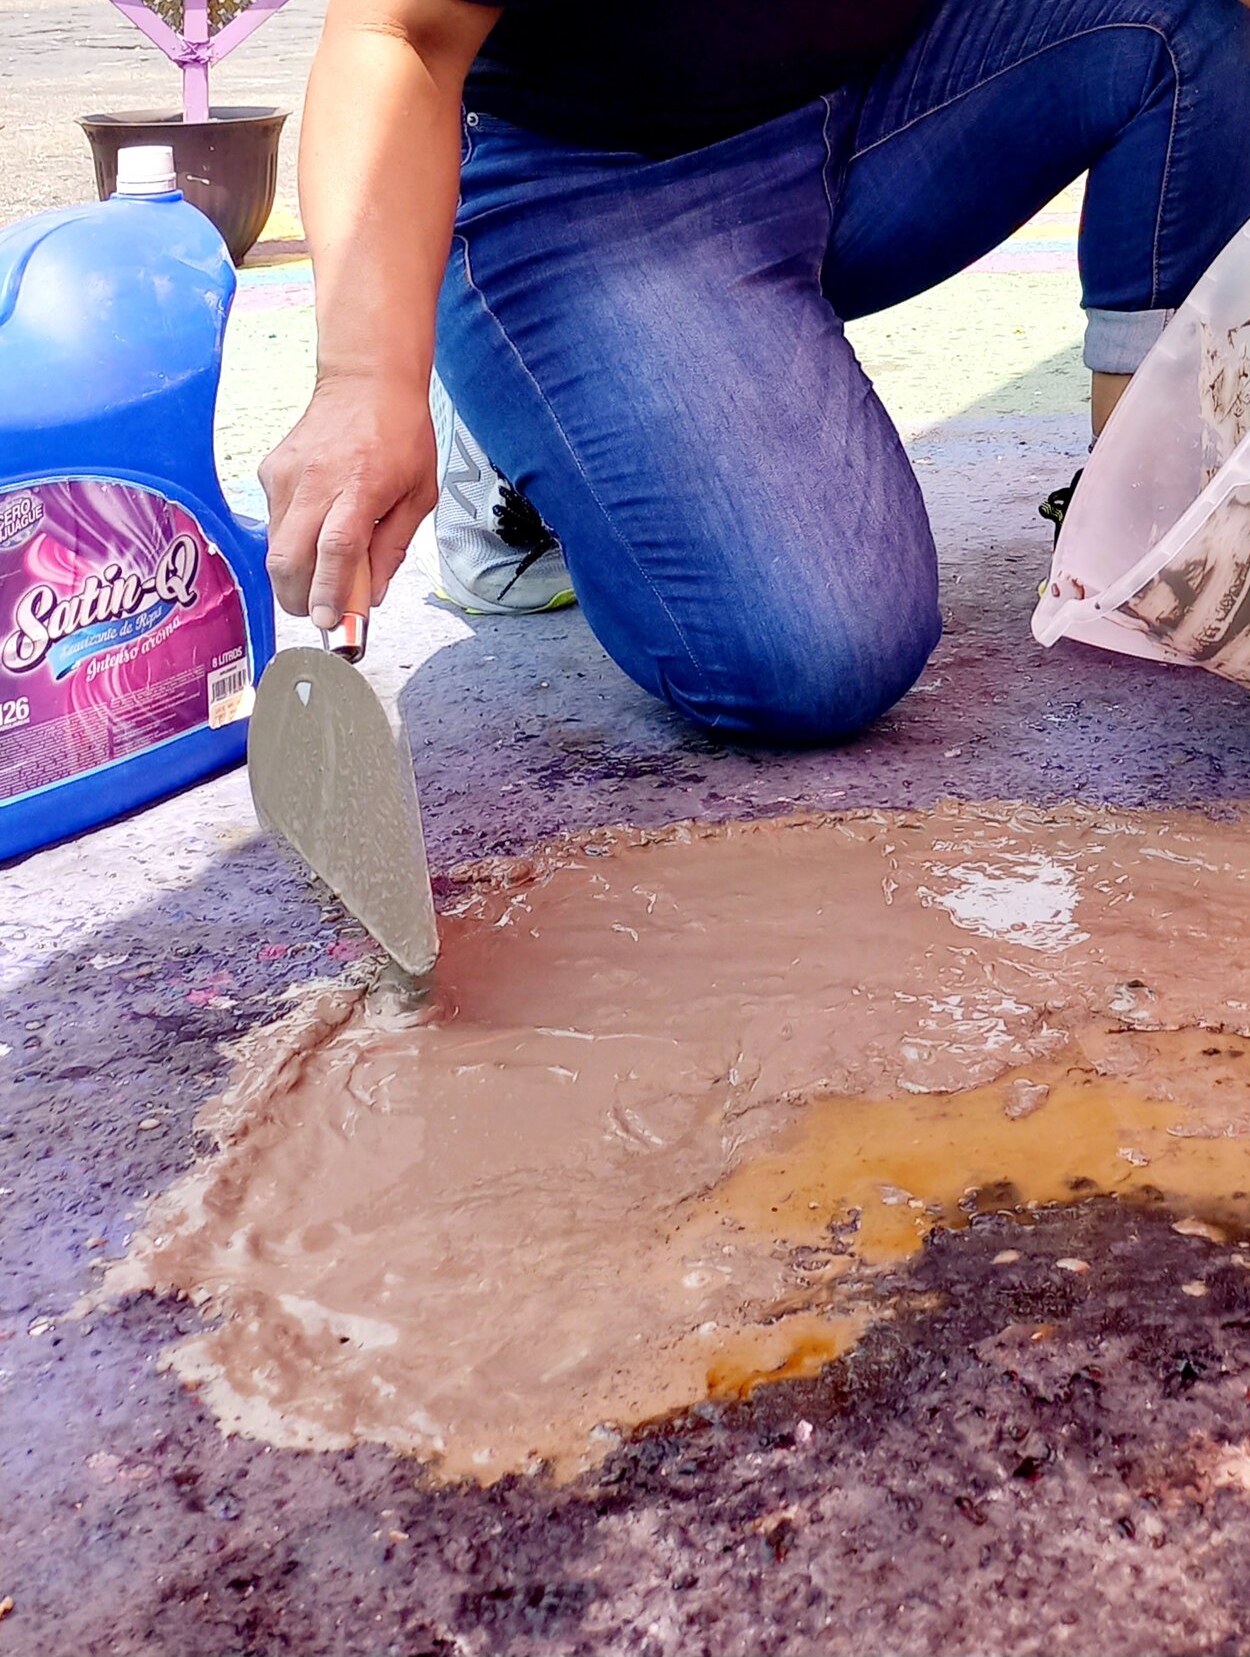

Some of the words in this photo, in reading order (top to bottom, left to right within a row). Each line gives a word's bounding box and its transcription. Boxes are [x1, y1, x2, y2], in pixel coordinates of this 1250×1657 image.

[0, 505, 43, 542] JUAGUE
[2, 533, 199, 674] Satin-Q
[119, 620, 134, 637] de
[86, 647, 139, 683] Intenso
[141, 614, 182, 655] aroma
[218, 646, 243, 666] LITROS
